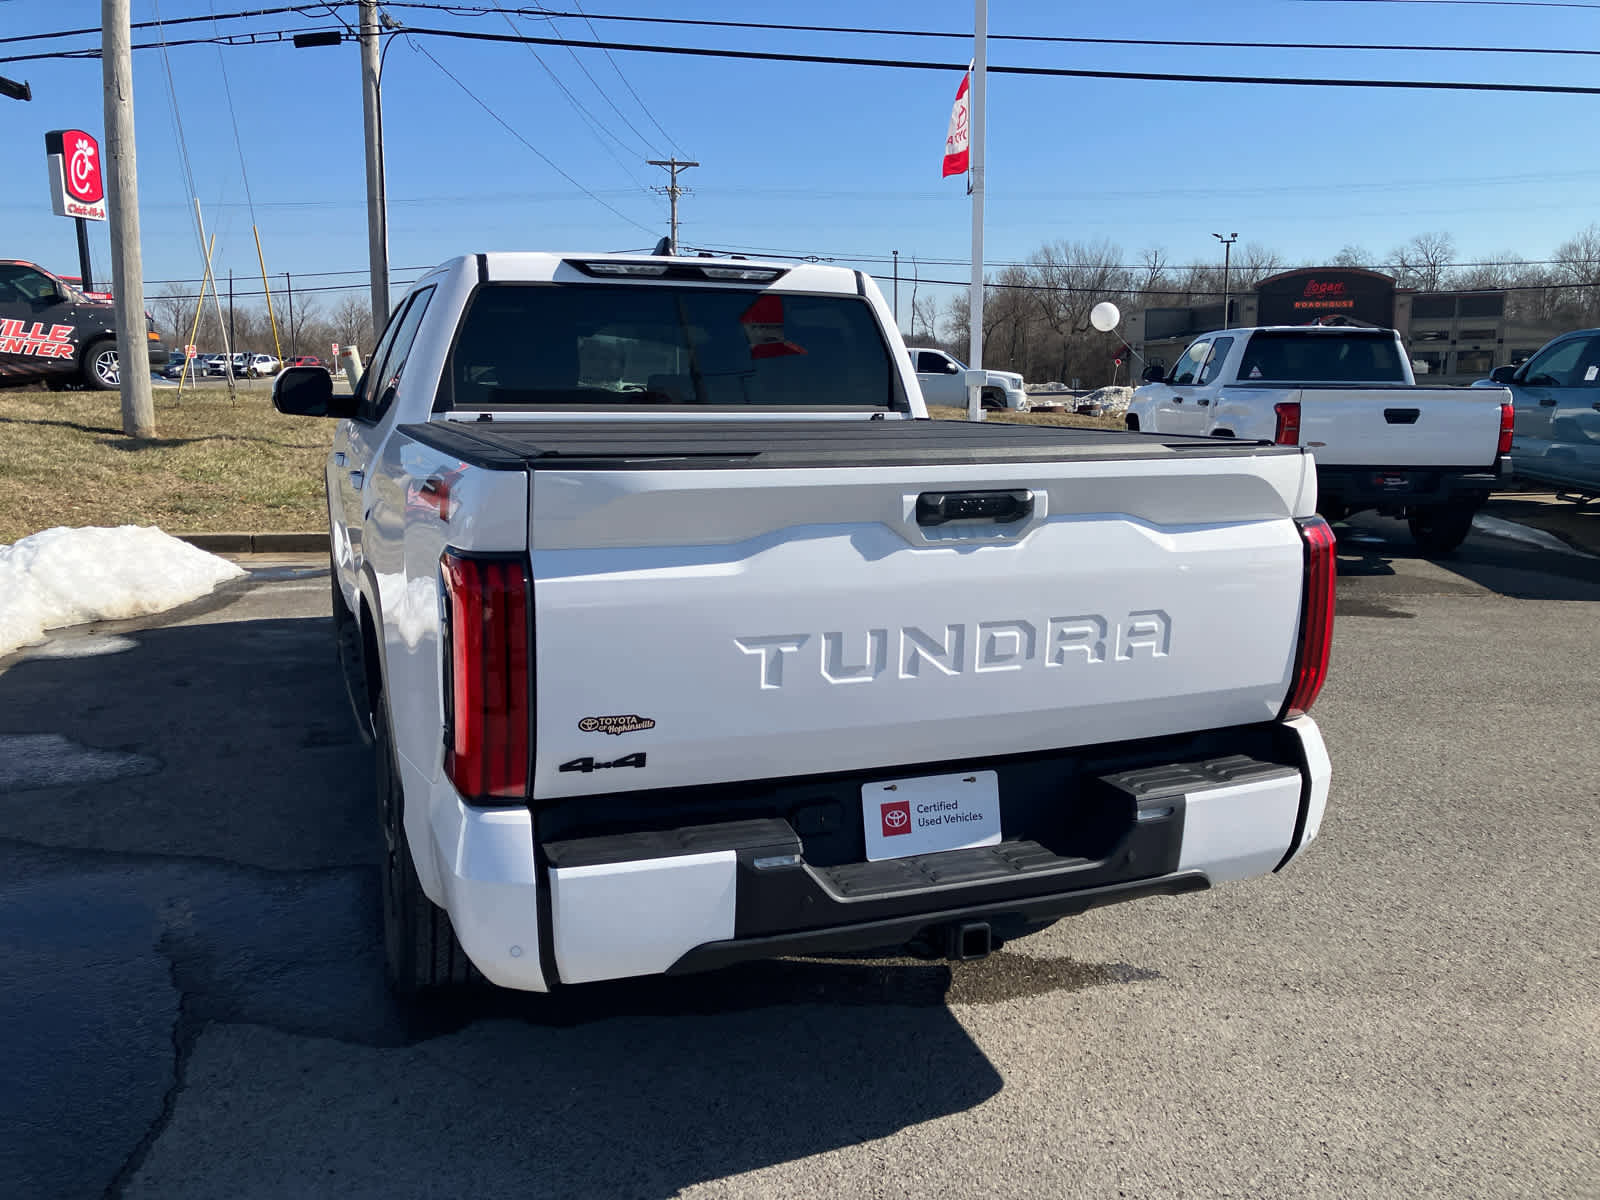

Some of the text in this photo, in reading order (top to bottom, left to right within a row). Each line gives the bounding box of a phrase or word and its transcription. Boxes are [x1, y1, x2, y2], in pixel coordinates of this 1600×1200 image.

[734, 609, 1172, 690] TUNDRA
[600, 716, 637, 725] TOYOTA
[916, 800, 958, 813] Certified
[918, 811, 984, 827] Used Vehicles
